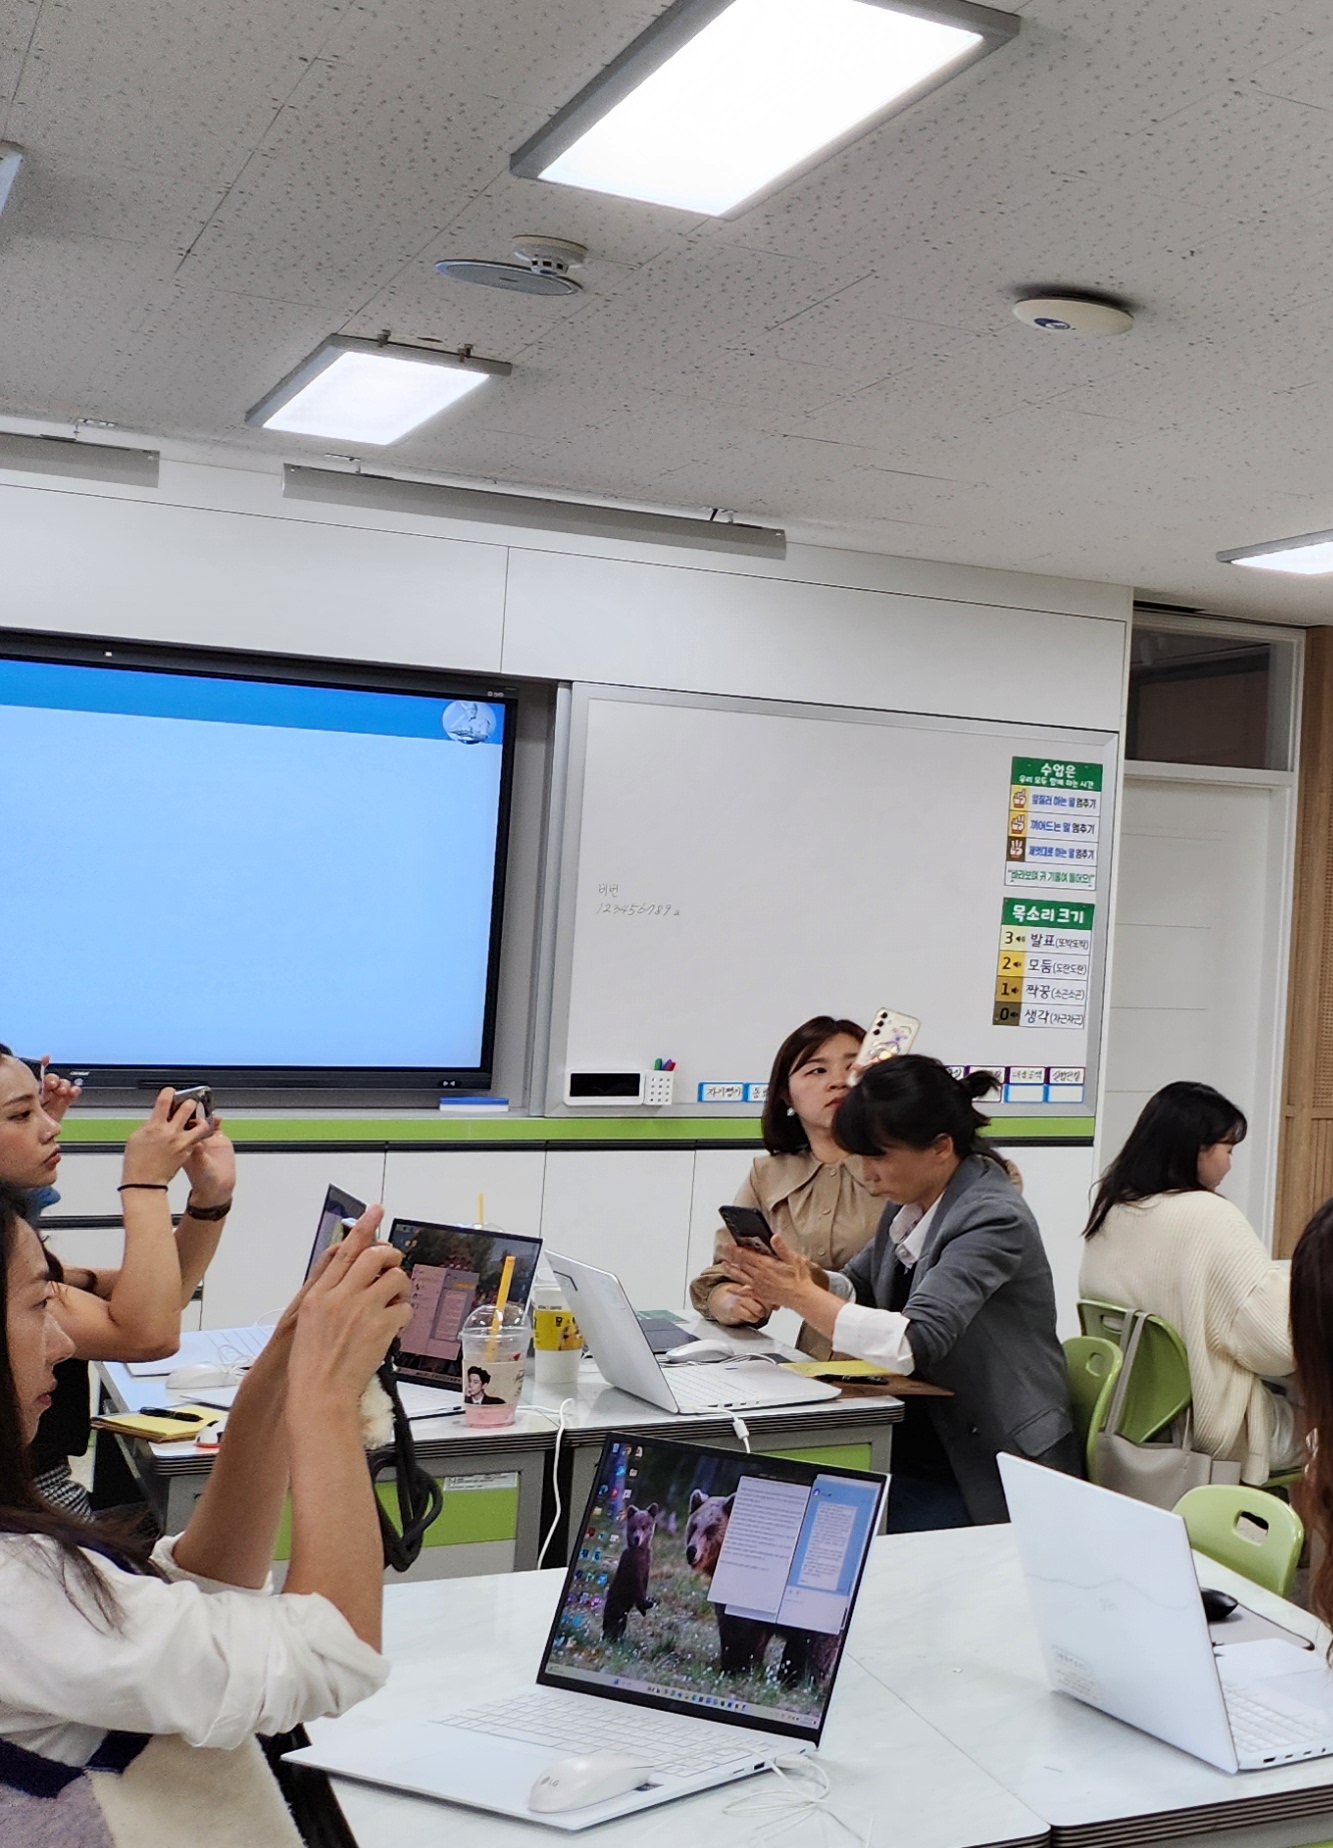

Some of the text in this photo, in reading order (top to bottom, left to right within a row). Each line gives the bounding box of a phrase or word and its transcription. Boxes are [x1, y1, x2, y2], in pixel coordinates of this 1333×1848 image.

[1041, 763, 1076, 779] 수업은
[1019, 774, 1033, 784] 우리
[1034, 776, 1047, 785] 모두
[1080, 780, 1094, 790] 시간
[1072, 822, 1095, 834] 멈추기
[1075, 848, 1095, 860] 멈추기
[1012, 904, 1084, 924] 목소리 크기
[1005, 931, 1013, 944] 3
[1030, 933, 1055, 947] 발표
[1002, 956, 1011, 970] 2
[1027, 959, 1052, 974] 모둠
[1001, 982, 1010, 996] 1
[1000, 1007, 1009, 1021] 0
[1024, 1009, 1050, 1024] 생각
